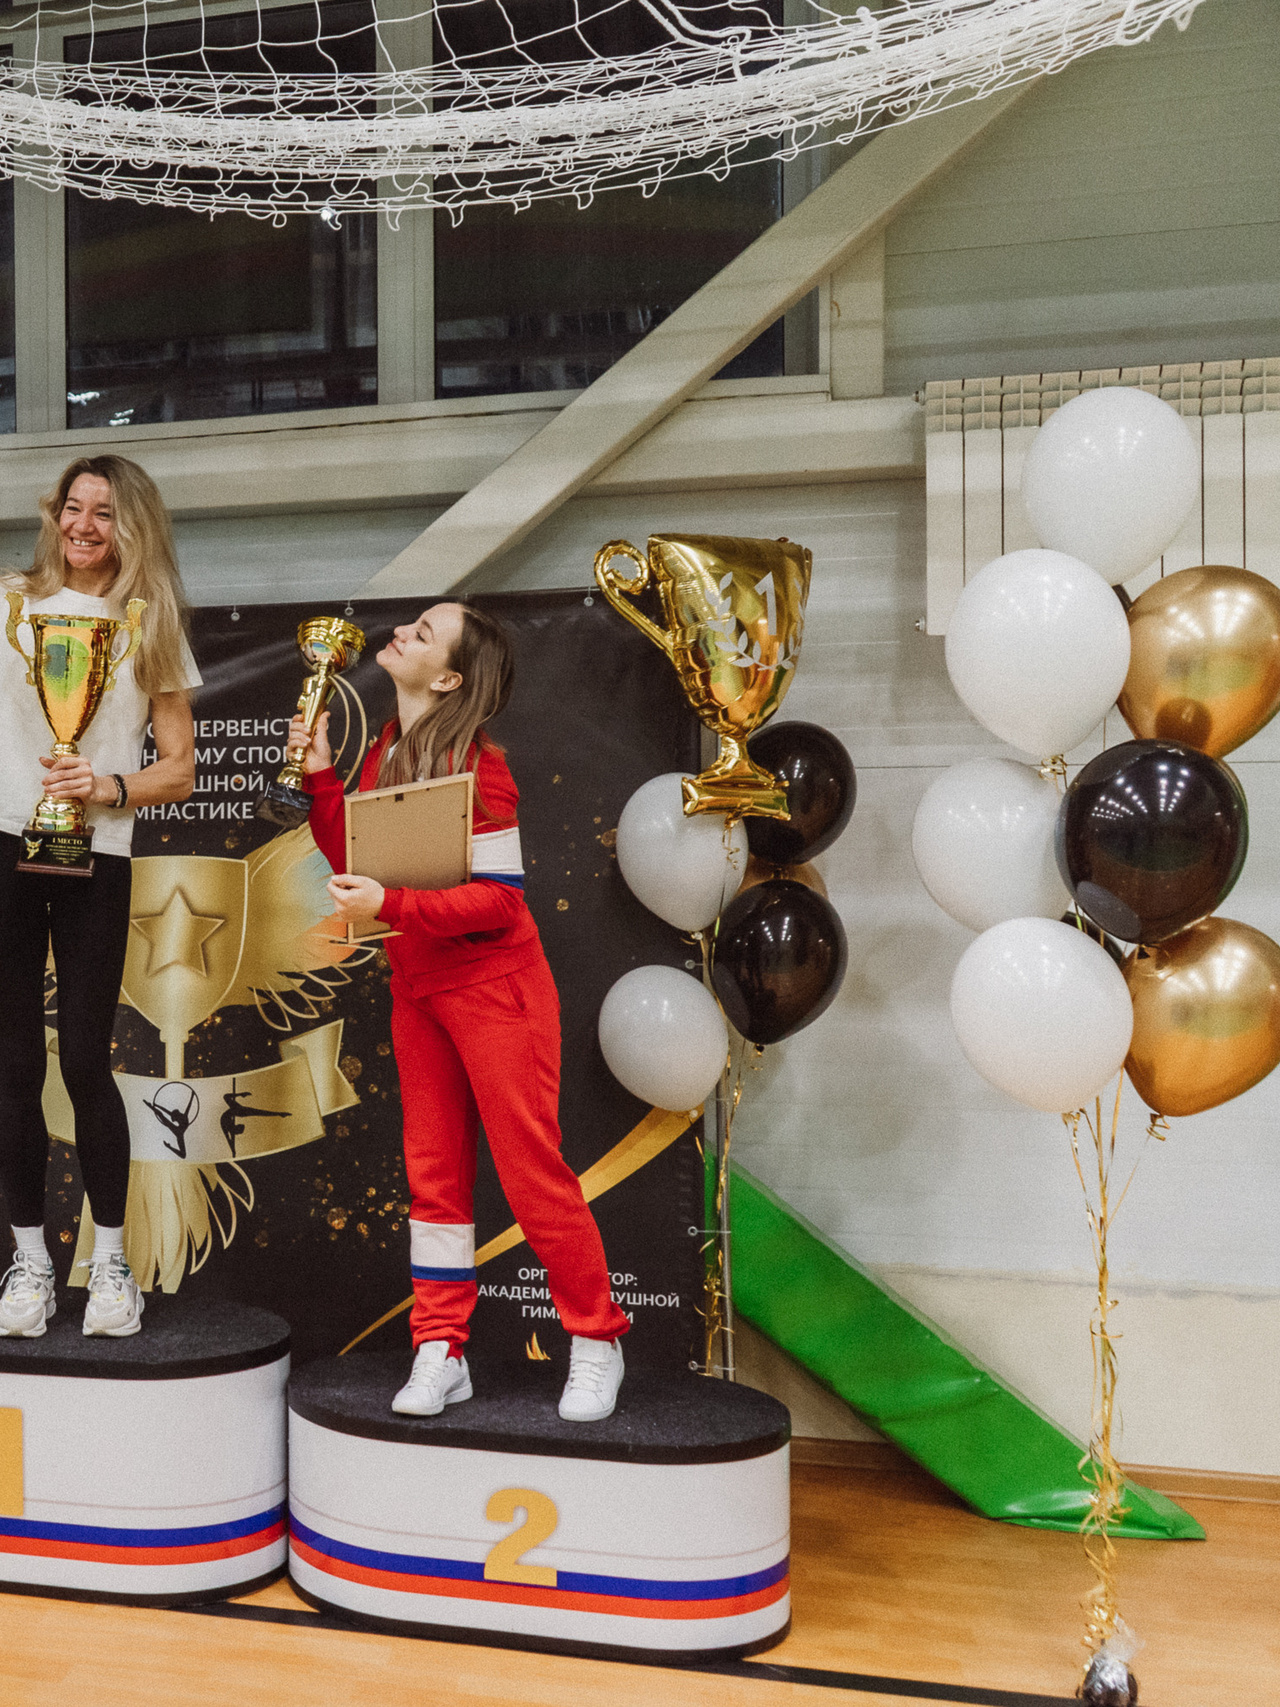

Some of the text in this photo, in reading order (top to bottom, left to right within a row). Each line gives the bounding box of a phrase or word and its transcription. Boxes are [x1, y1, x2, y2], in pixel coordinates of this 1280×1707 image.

[754, 571, 777, 635] 1
[135, 802, 254, 820] МНАСТИКЕ
[483, 1488, 558, 1588] 2
